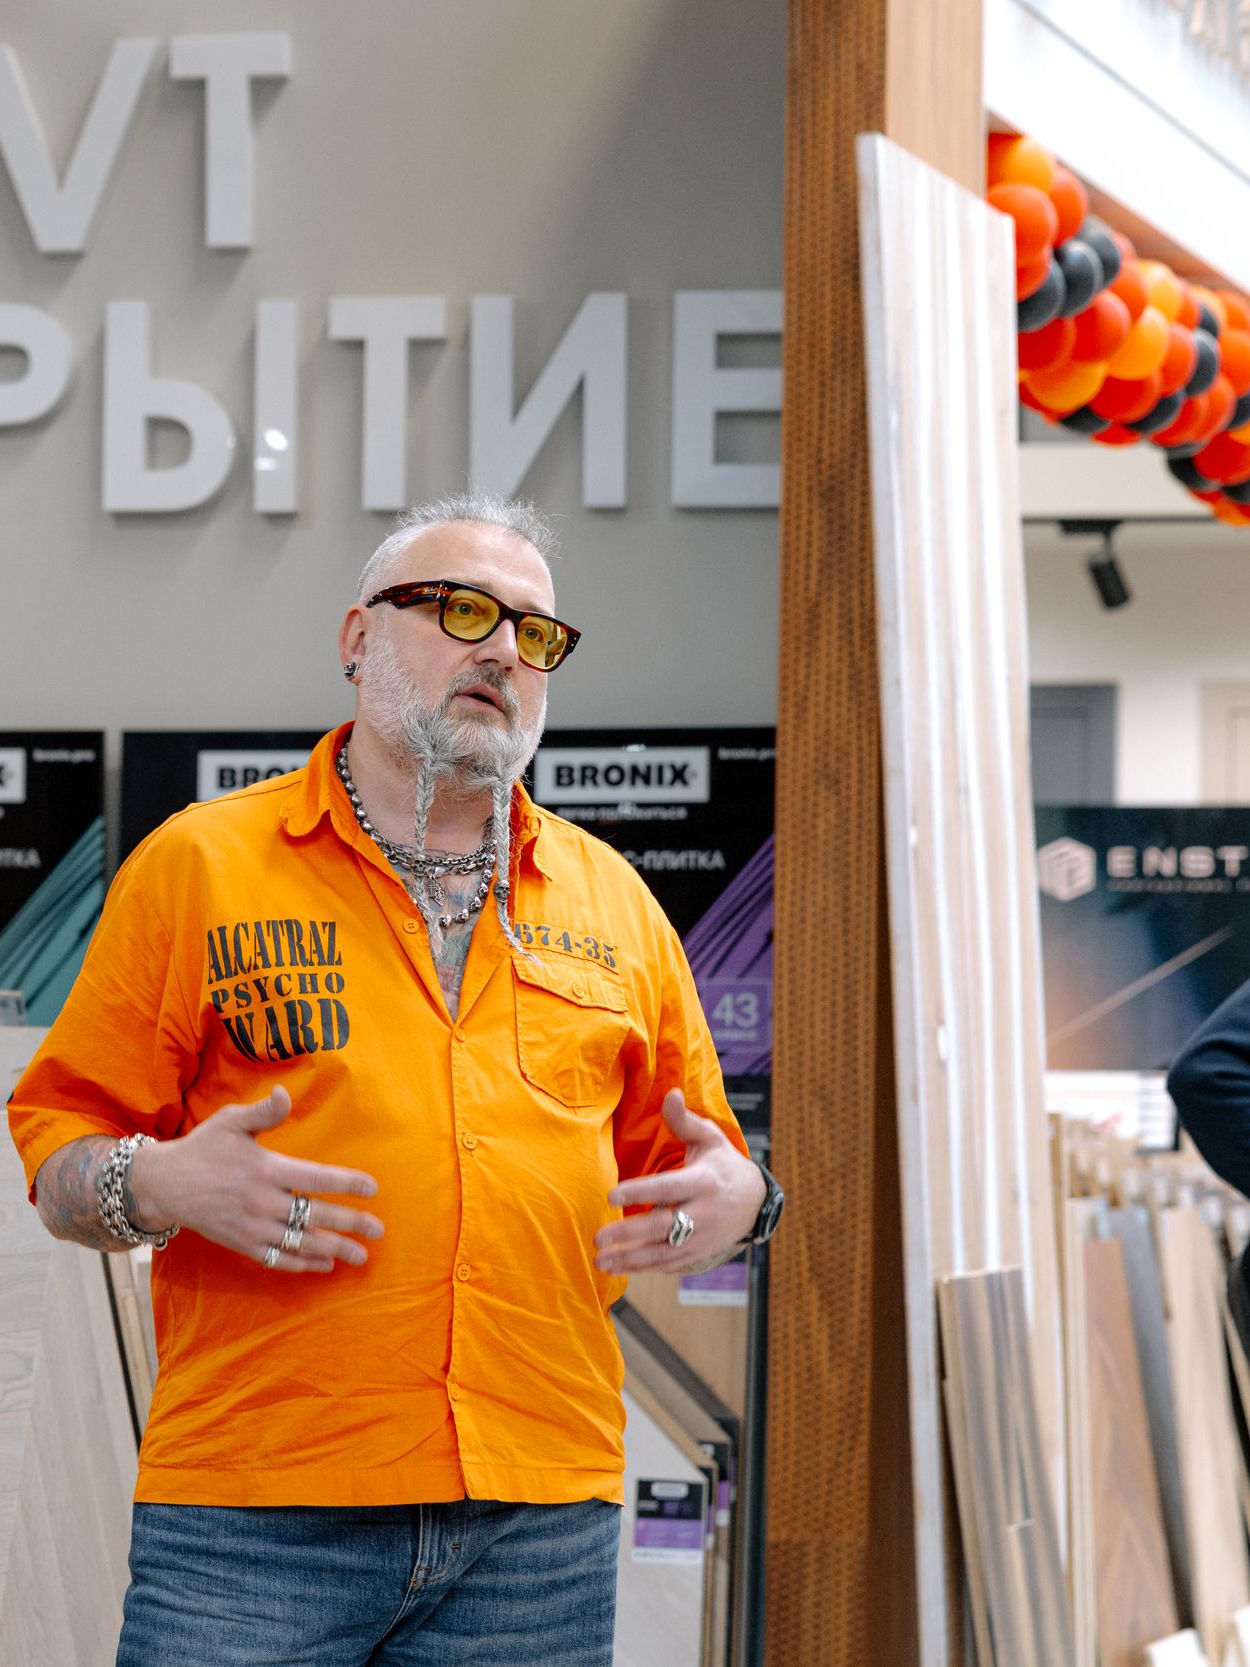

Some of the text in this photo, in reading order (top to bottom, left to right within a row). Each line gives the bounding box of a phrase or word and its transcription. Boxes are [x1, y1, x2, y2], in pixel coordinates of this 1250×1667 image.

[555, 763, 690, 787] BRONIX
[207, 919, 342, 985] ALCATRAZ
[514, 922, 618, 968] 674-35
[210, 972, 345, 1013] PSYCHO
[712, 991, 760, 1029] 43
[222, 998, 350, 1062] WARD
